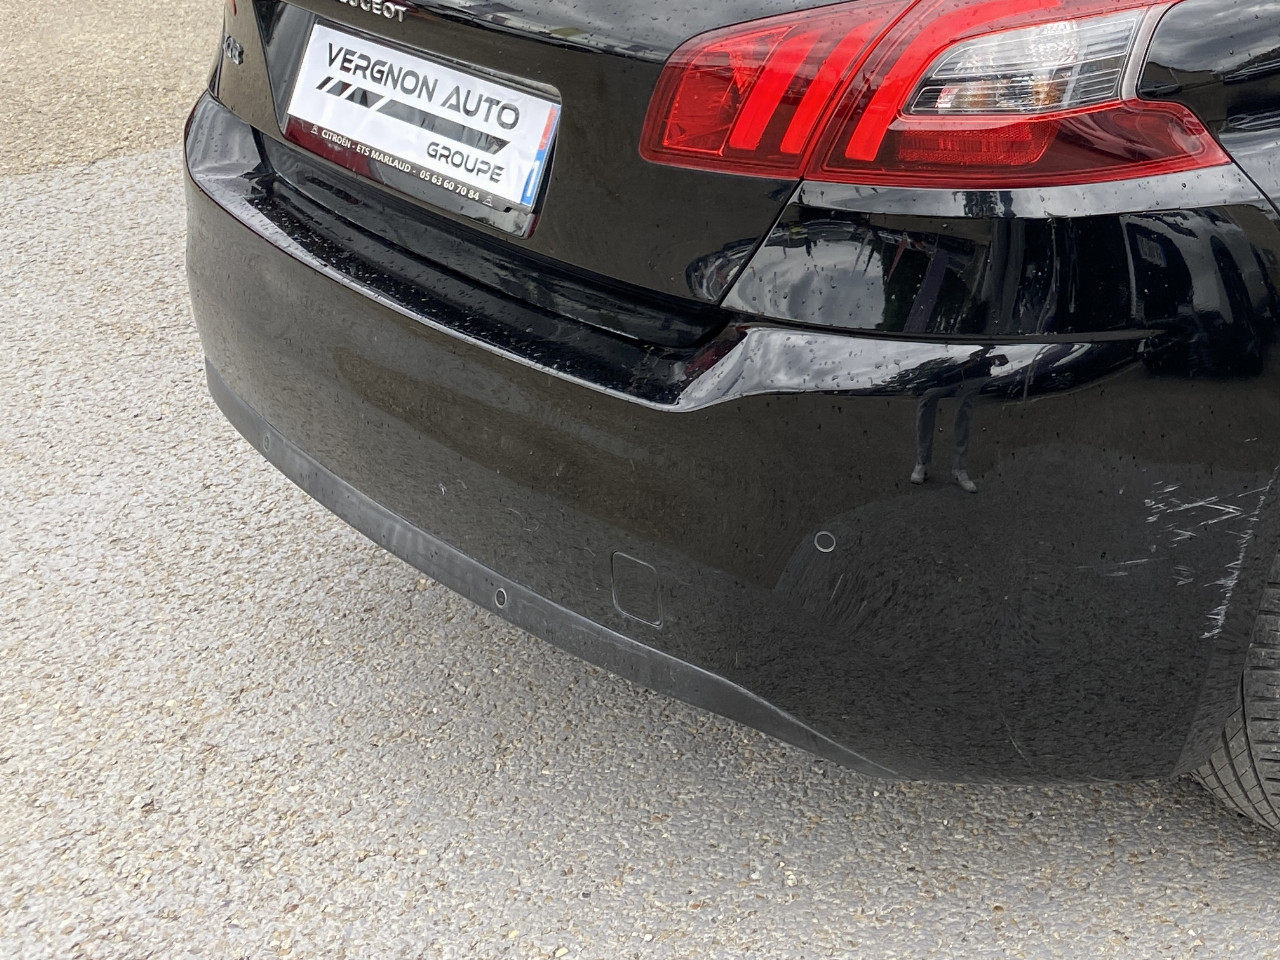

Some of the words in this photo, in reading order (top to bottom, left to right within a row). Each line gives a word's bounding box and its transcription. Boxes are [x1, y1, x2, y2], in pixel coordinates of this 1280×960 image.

[328, 42, 438, 102] VERGNON
[440, 85, 520, 130] AUTO
[321, 129, 352, 149] CITROËN
[356, 144, 370, 156] ETS
[370, 150, 411, 173] MARLAUD
[420, 170, 430, 181] 05
[432, 175, 442, 186] 63
[443, 179, 454, 190] 60
[456, 184, 467, 196] 70
[468, 189, 479, 201] 84
[426, 141, 505, 184] GROUPE
